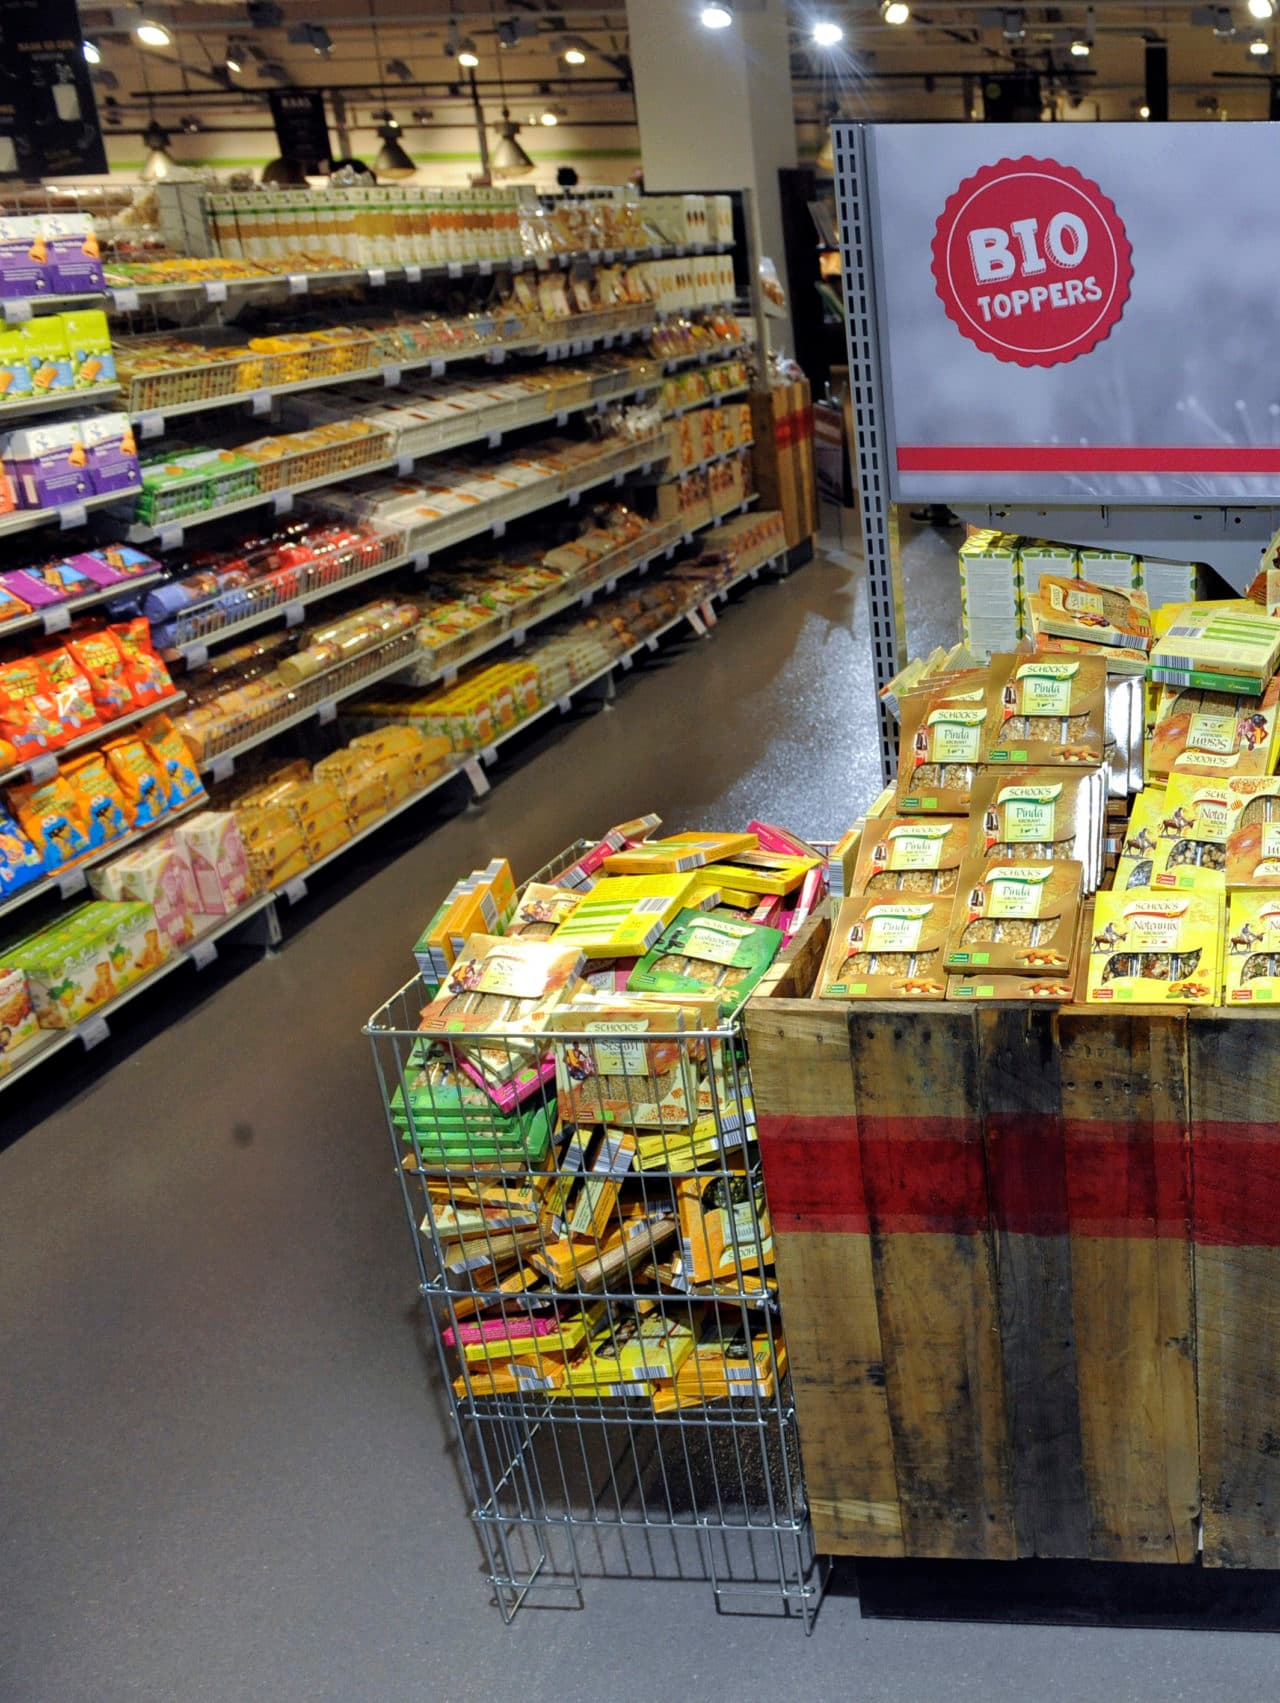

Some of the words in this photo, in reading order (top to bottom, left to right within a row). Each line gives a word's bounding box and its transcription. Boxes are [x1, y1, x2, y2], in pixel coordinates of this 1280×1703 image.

[967, 211, 1089, 286] BIO
[977, 276, 1103, 322] TOPPERS
[1026, 663, 1069, 674] SCHOCK'S
[1033, 681, 1061, 694] Pinda
[937, 710, 979, 719] SCHOCK'S
[943, 727, 970, 740] Pinda
[1008, 787, 1052, 797] SCHOCK'S
[1015, 805, 1044, 819] Pinda
[997, 868, 1042, 877] SCHOCK'S
[1002, 884, 1031, 897] Pinda
[1134, 902, 1180, 911] SCHOCK'S
[1133, 919, 1178, 931] Notenmix
